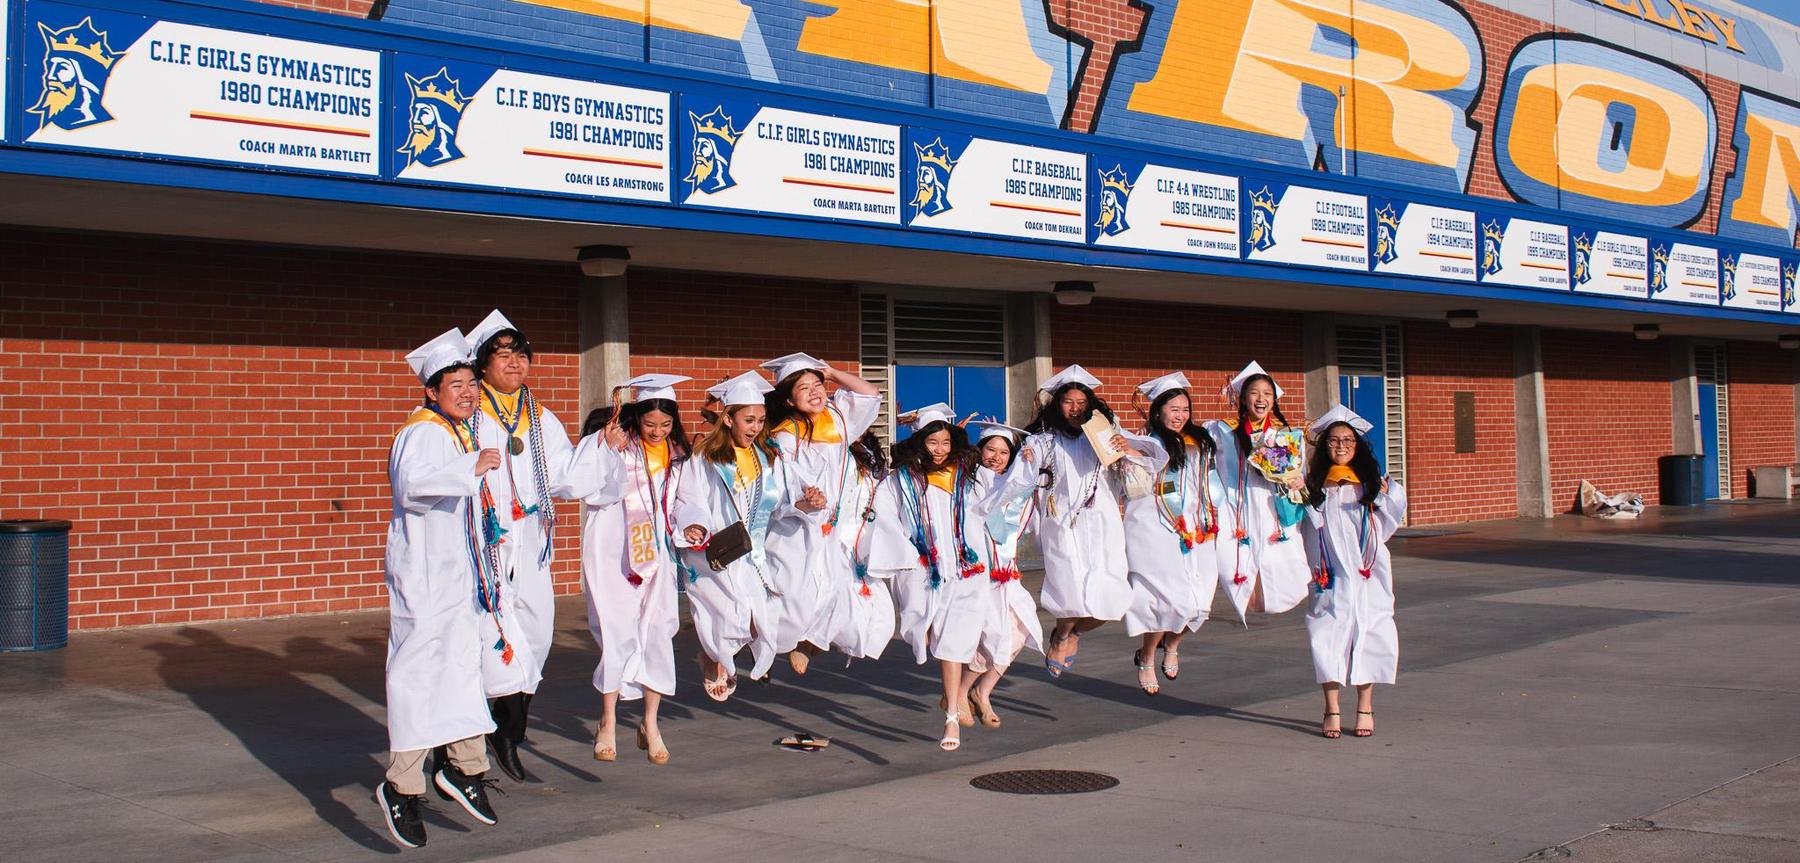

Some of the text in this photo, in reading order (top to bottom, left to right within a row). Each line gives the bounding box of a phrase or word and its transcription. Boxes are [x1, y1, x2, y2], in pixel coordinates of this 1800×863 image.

[151, 41, 371, 88] C.I.F. GIRLS GYMNASTICS
[221, 81, 371, 117] 1980 CHAMPIONS
[497, 87, 664, 125] C.I.F. BOYS GYMNASTICS
[550, 121, 664, 151] 1981 CHAMPIONS
[758, 122, 895, 156] C.I.F. GIRLS GYMNASTICS
[240, 140, 371, 163] COACH MARTA BARTLETT
[805, 152, 895, 178] 1981 CHAMPIONS
[1012, 158, 1082, 182] C.I.F. BASEBALL
[565, 173, 664, 192] COACH LES ARMSTRONG
[1006, 179, 1082, 202] 1985 CHAMPIONS
[1157, 179, 1235, 202] C.I.F. 4-A WRESTLING
[814, 198, 895, 215] COACH MARTA BARTLETT
[1173, 201, 1236, 221] 1985 CHAMPIONS
[1316, 201, 1365, 219] C.I.F. FOOTBALL
[1025, 221, 1082, 235] COACH TOM DEKRAAI
[1328, 221, 1365, 237] CHAMPIONS
[1445, 219, 1473, 234] BASEBALL
[1187, 239, 1237, 251] COACH JOHN ROSALES
[1442, 235, 1473, 249] CHAMPIONS
[1542, 233, 1566, 246] BASEBALL
[1327, 253, 1339, 262] COACH
[1540, 248, 1566, 260] CHAMPIONS
[1620, 244, 1646, 257] VOLLEYBALL
[1623, 259, 1646, 270] CHAMPIONS
[632, 523, 653, 545] 20
[633, 543, 655, 563] 26
